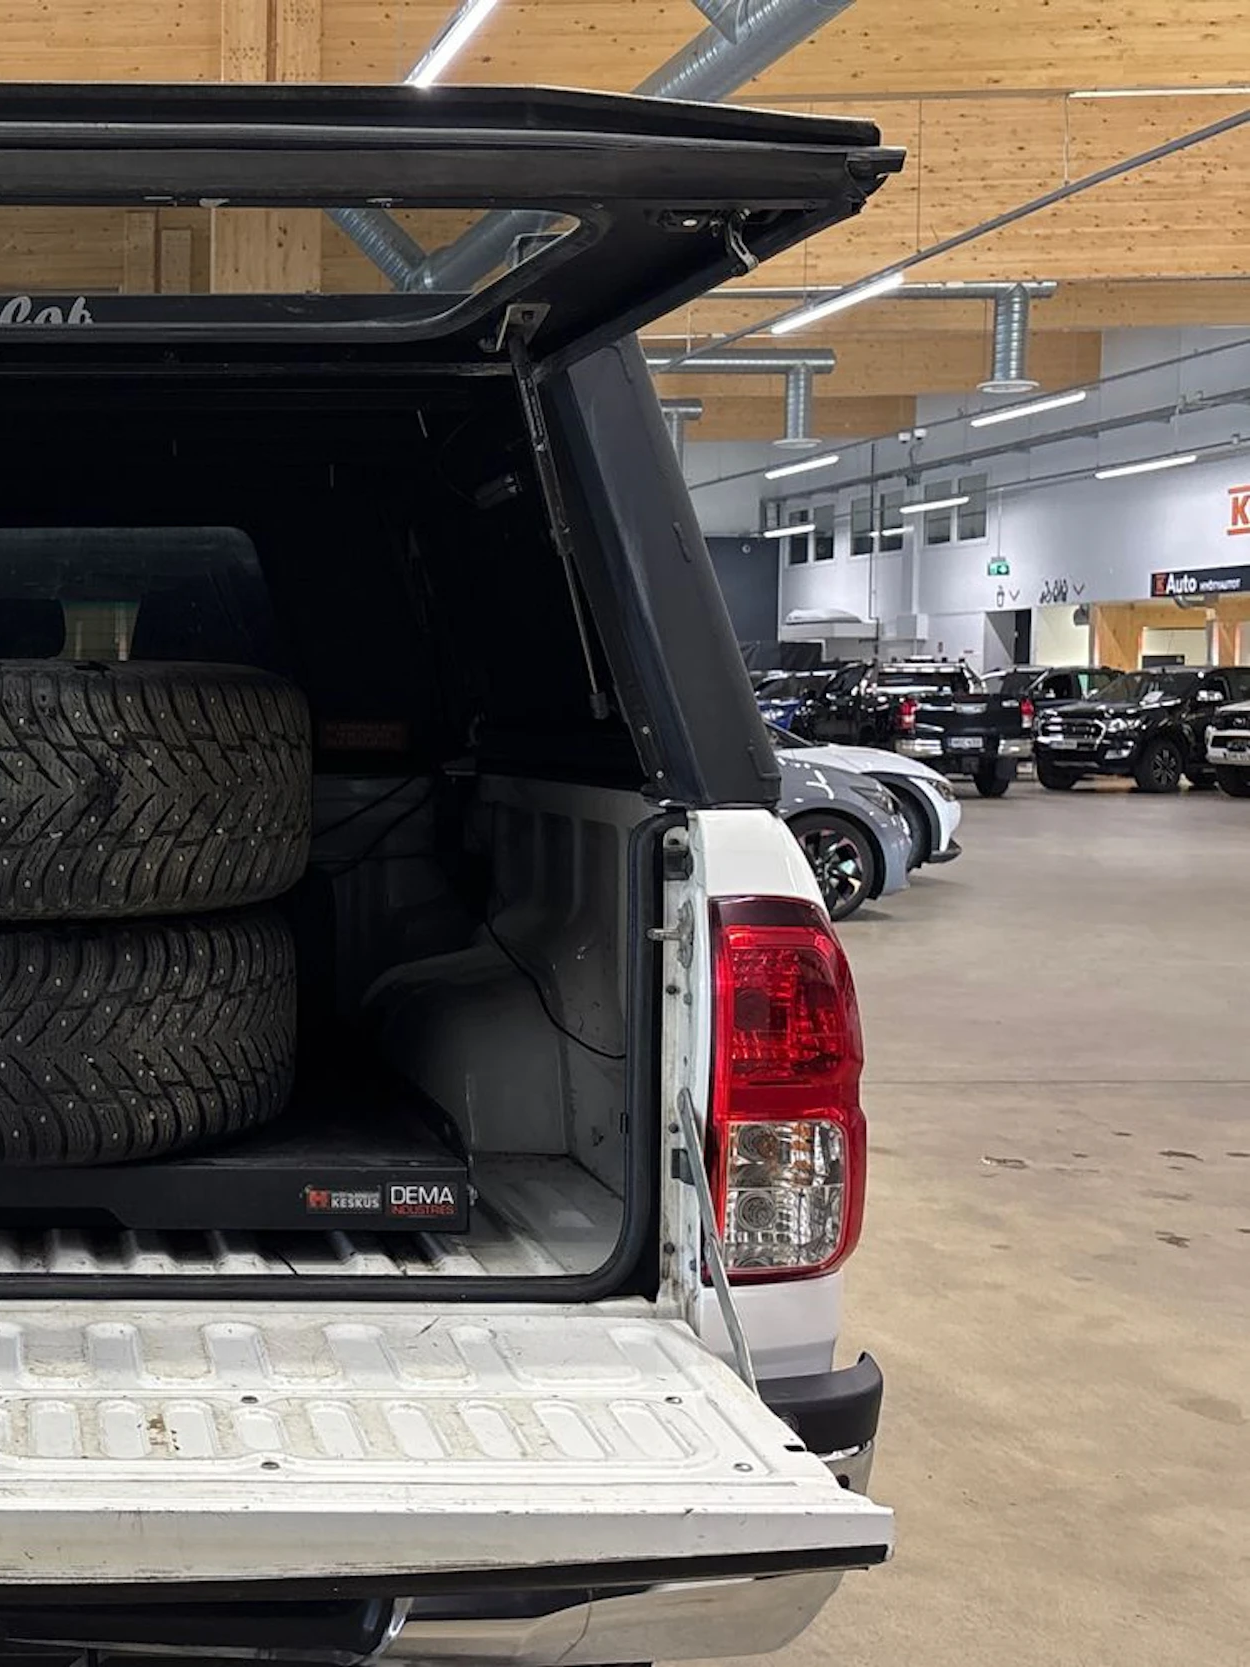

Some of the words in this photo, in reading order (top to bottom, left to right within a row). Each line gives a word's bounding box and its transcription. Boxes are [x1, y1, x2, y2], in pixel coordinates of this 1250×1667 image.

[1231, 496, 1250, 526] K
[1165, 574, 1198, 594] Auto
[331, 1198, 380, 1209] KESKUS
[390, 1186, 455, 1204] DEMA
[391, 1204, 455, 1214] INDUSTRIES
